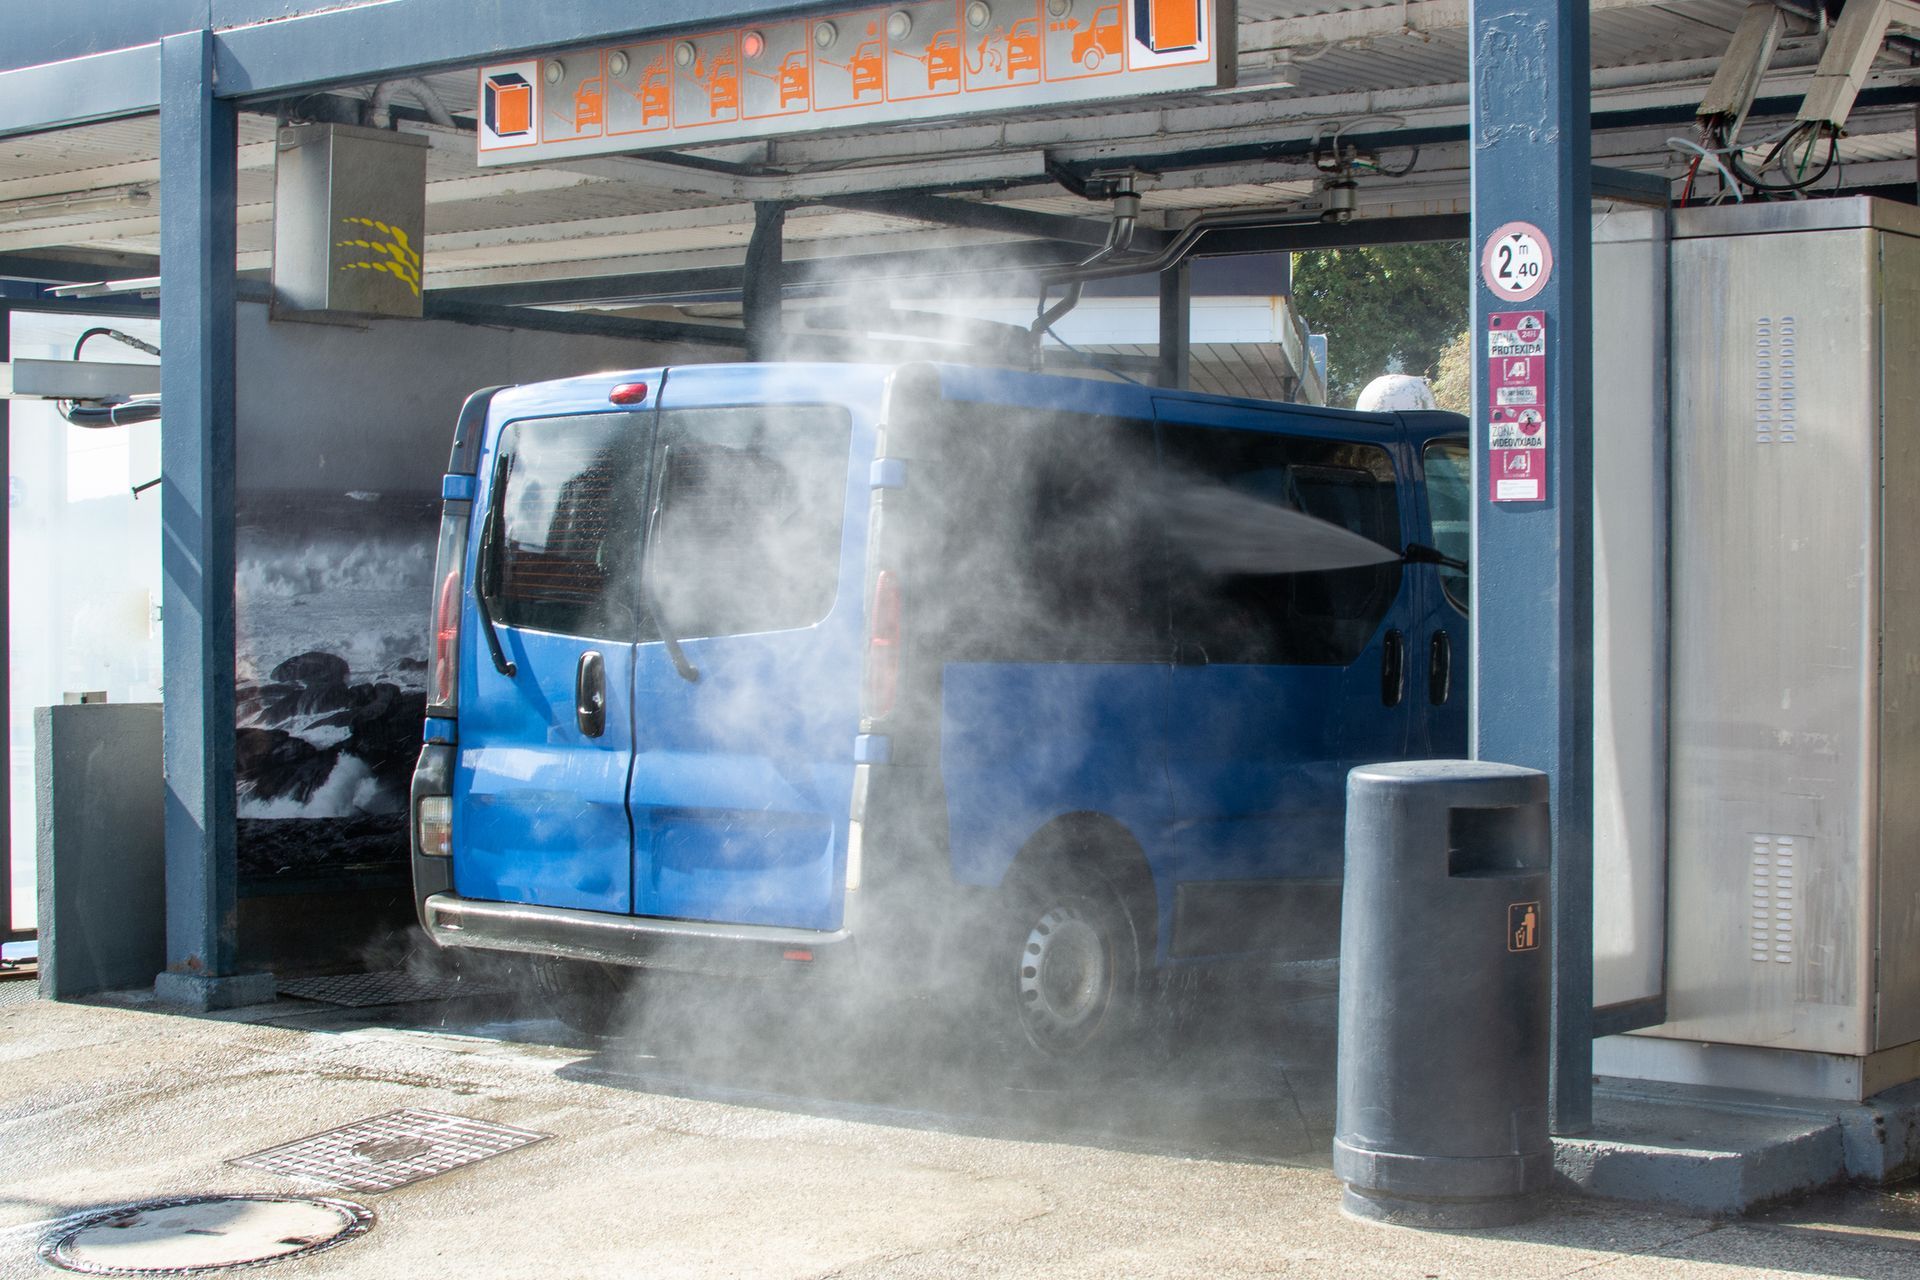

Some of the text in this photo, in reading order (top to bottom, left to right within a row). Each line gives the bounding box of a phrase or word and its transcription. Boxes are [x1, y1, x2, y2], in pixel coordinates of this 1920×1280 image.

[1519, 245, 1529, 255] m
[1491, 344, 1542, 355] PROTEXIDA
[1492, 425, 1515, 437] ZONA
